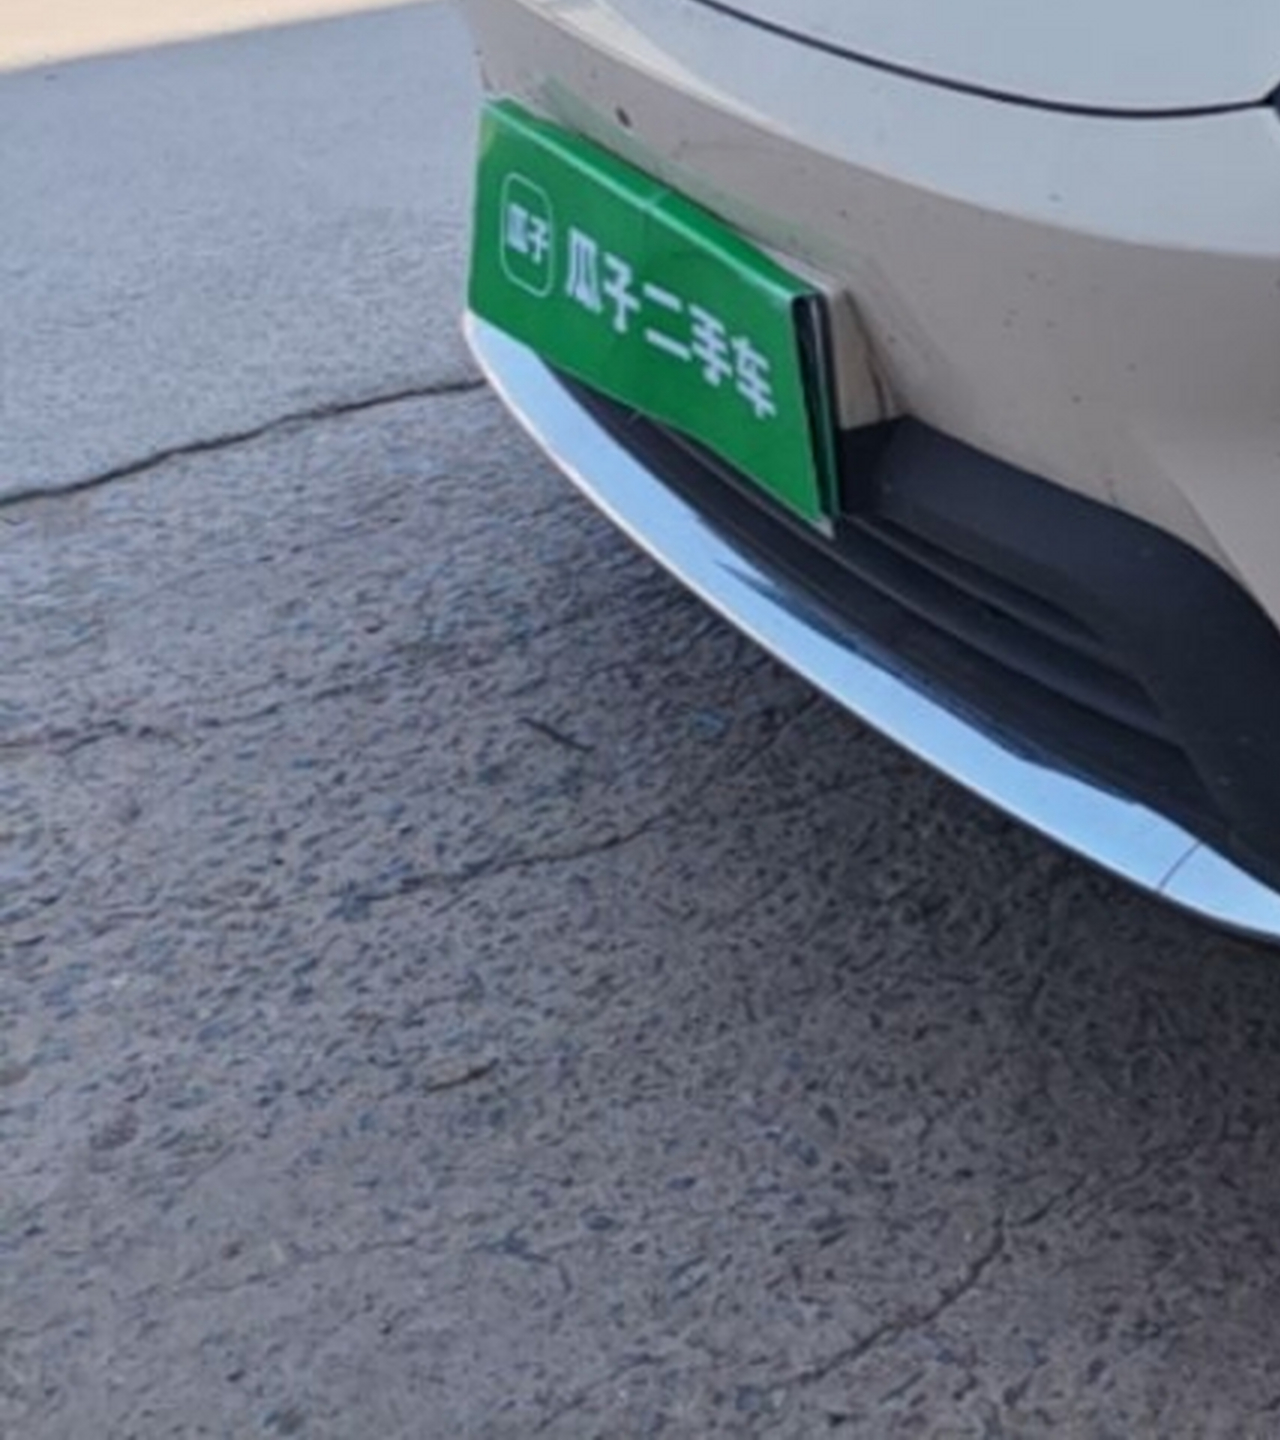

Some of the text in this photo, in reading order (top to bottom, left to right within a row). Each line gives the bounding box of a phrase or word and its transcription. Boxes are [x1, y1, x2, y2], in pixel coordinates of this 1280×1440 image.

[565, 226, 777, 419] 瓜子二手车
